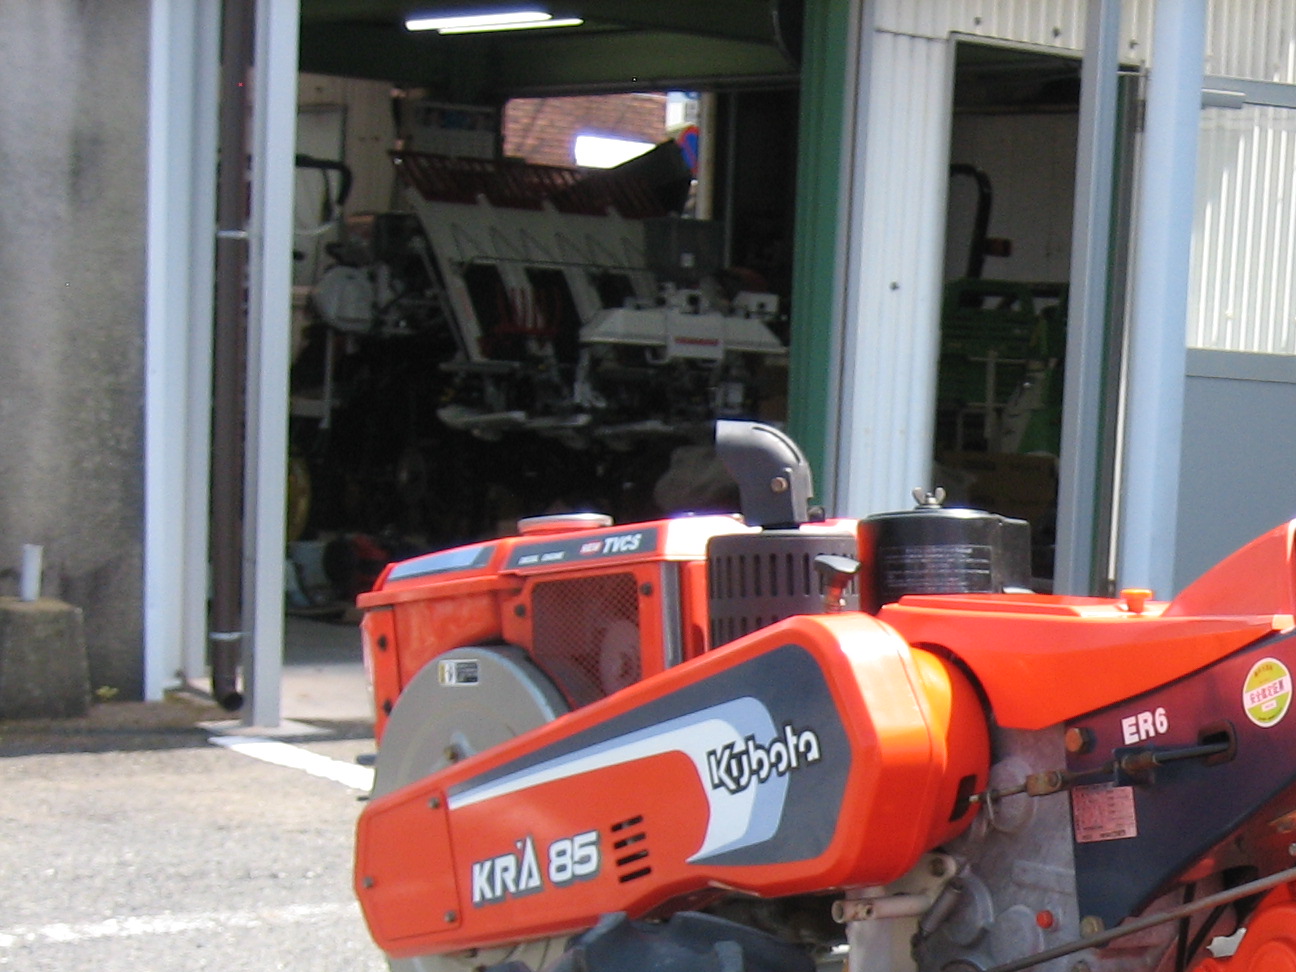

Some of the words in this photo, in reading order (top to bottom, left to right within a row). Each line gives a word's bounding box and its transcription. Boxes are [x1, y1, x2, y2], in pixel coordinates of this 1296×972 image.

[602, 533, 642, 554] TVCS
[1121, 706, 1169, 746] ER6
[707, 724, 821, 794] Kubota
[471, 834, 544, 906] KRA
[548, 829, 600, 886] 85
